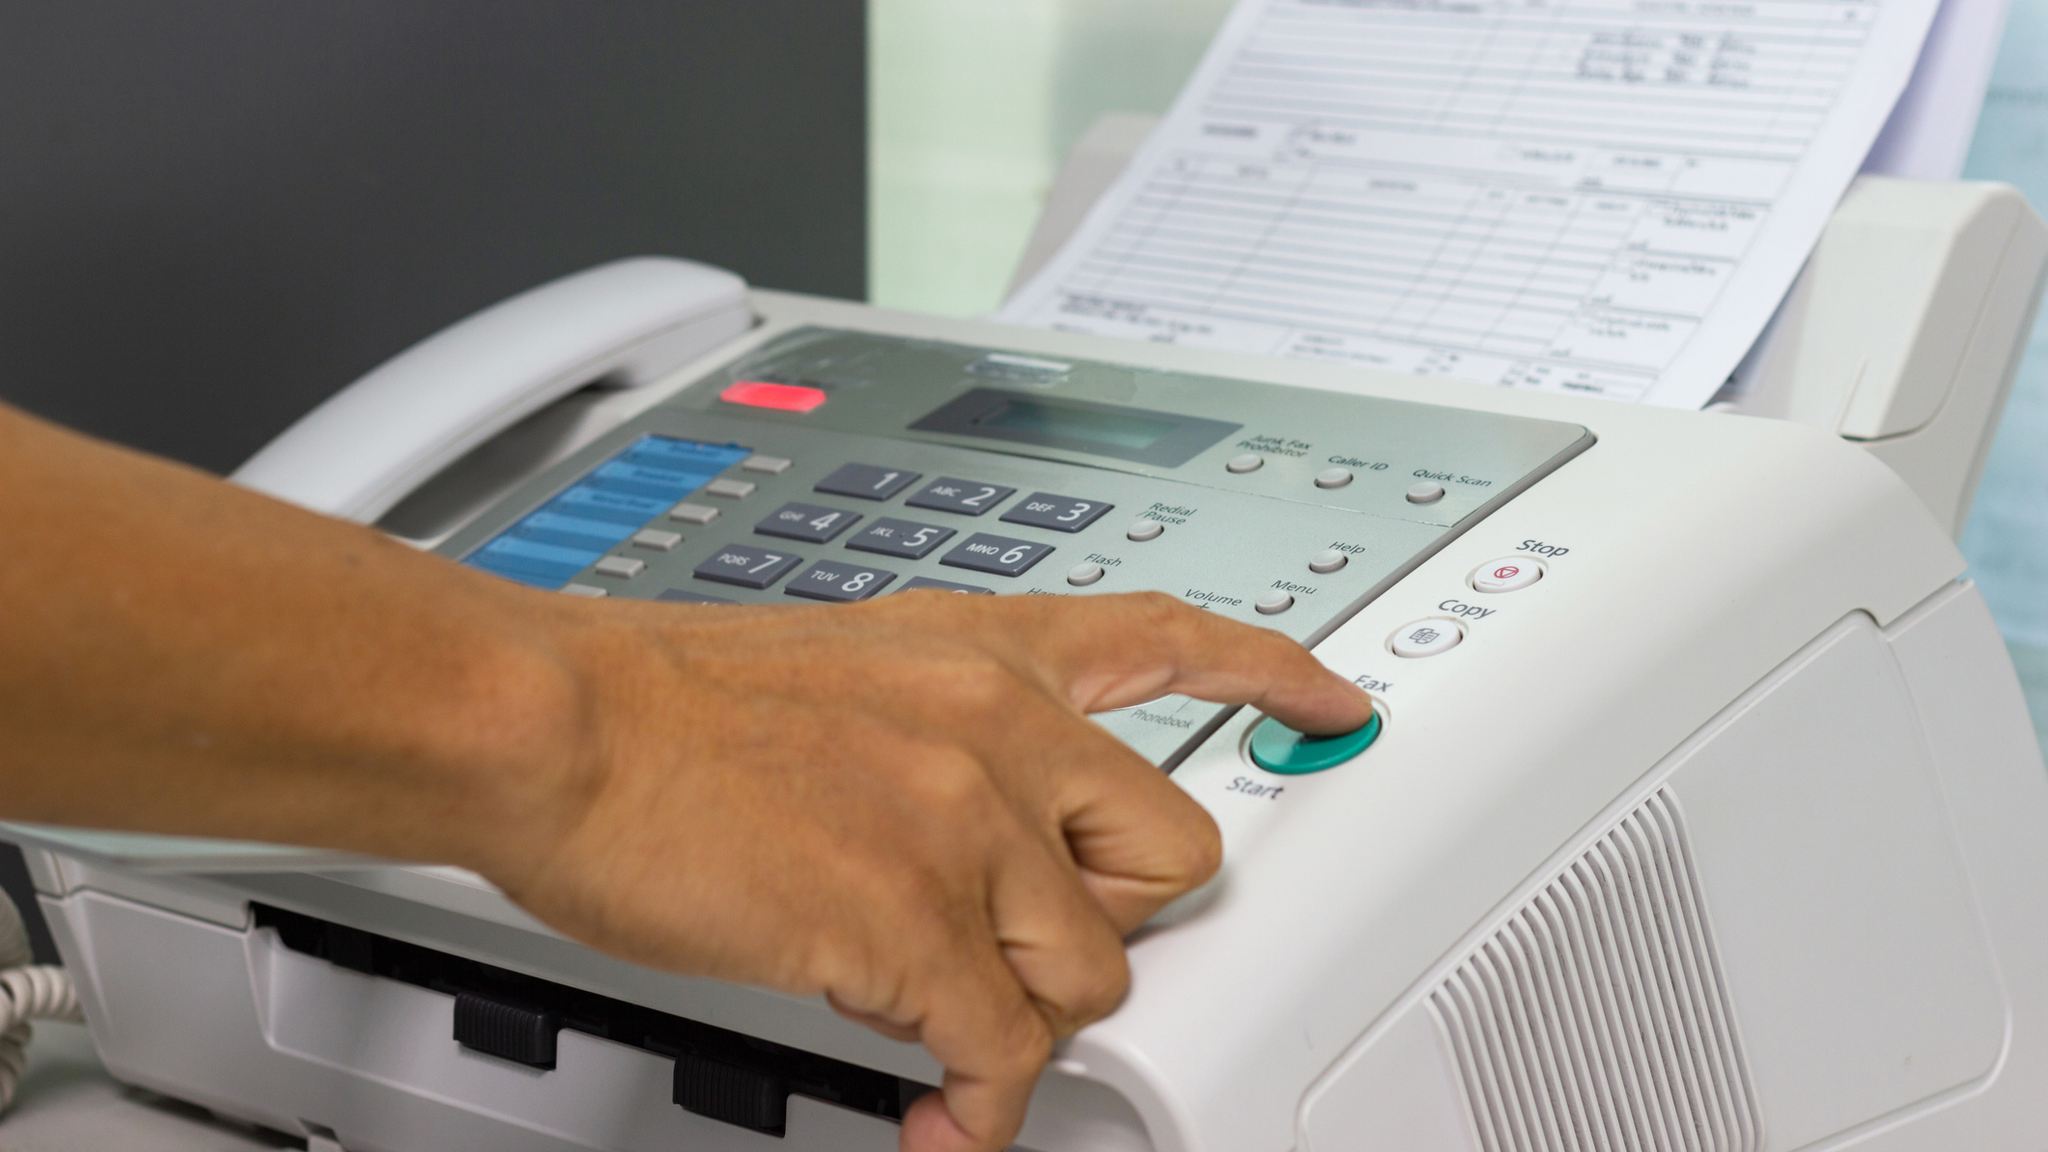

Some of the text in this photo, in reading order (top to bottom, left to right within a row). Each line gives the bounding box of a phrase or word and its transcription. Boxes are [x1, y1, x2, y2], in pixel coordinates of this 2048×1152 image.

[1236, 440, 1308, 457] Prohibitor
[1250, 433, 1313, 451] Junk Fax
[1328, 455, 1389, 472] Caller ID
[874, 472, 898, 490] 1
[1412, 469, 1492, 488] Quick Scan
[930, 485, 996, 506] ABC 2
[1026, 502, 1091, 522] DEF 3
[1135, 510, 1186, 525] /Pause
[1149, 502, 1198, 516] Redial
[780, 511, 842, 531] GHI 4
[870, 526, 939, 548] JKL 5
[967, 543, 1032, 565] MNO 6
[1328, 541, 1366, 556] Help
[1516, 539, 1569, 558] Stop
[718, 553, 782, 574] PQRS 7
[1084, 553, 1122, 567] Flash
[811, 570, 875, 592] TUV 8
[1271, 579, 1317, 596] Menu
[1185, 588, 1243, 607] Volume
[1438, 599, 1497, 620] Copy
[1353, 674, 1394, 693] Fax
[1130, 708, 1195, 729] Phonebook
[1226, 776, 1285, 800] Start
